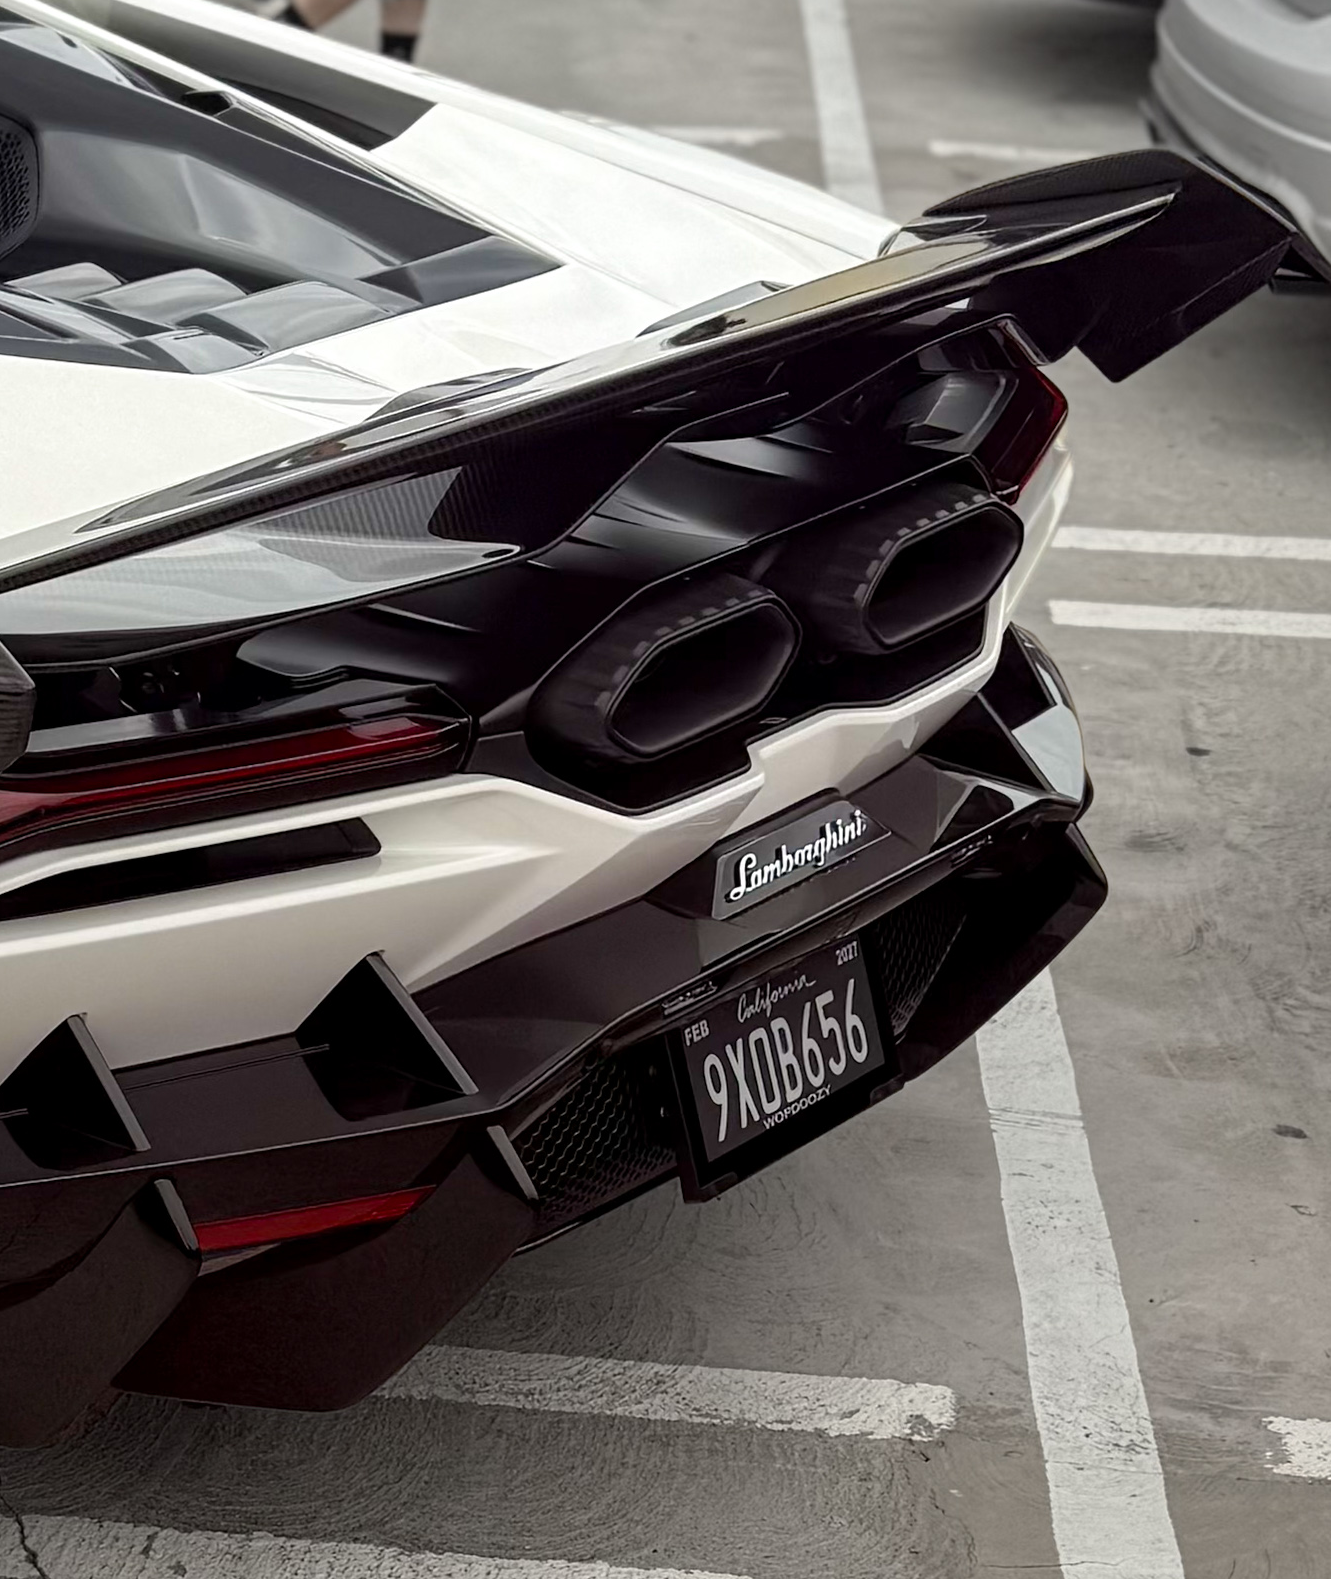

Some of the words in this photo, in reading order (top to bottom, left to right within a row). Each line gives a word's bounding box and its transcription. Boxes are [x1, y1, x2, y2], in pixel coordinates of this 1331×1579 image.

[729, 809, 863, 901] Lamborghini
[684, 1019, 710, 1047] FEB
[737, 972, 817, 1023] California
[703, 978, 869, 1142] 9XOB656
